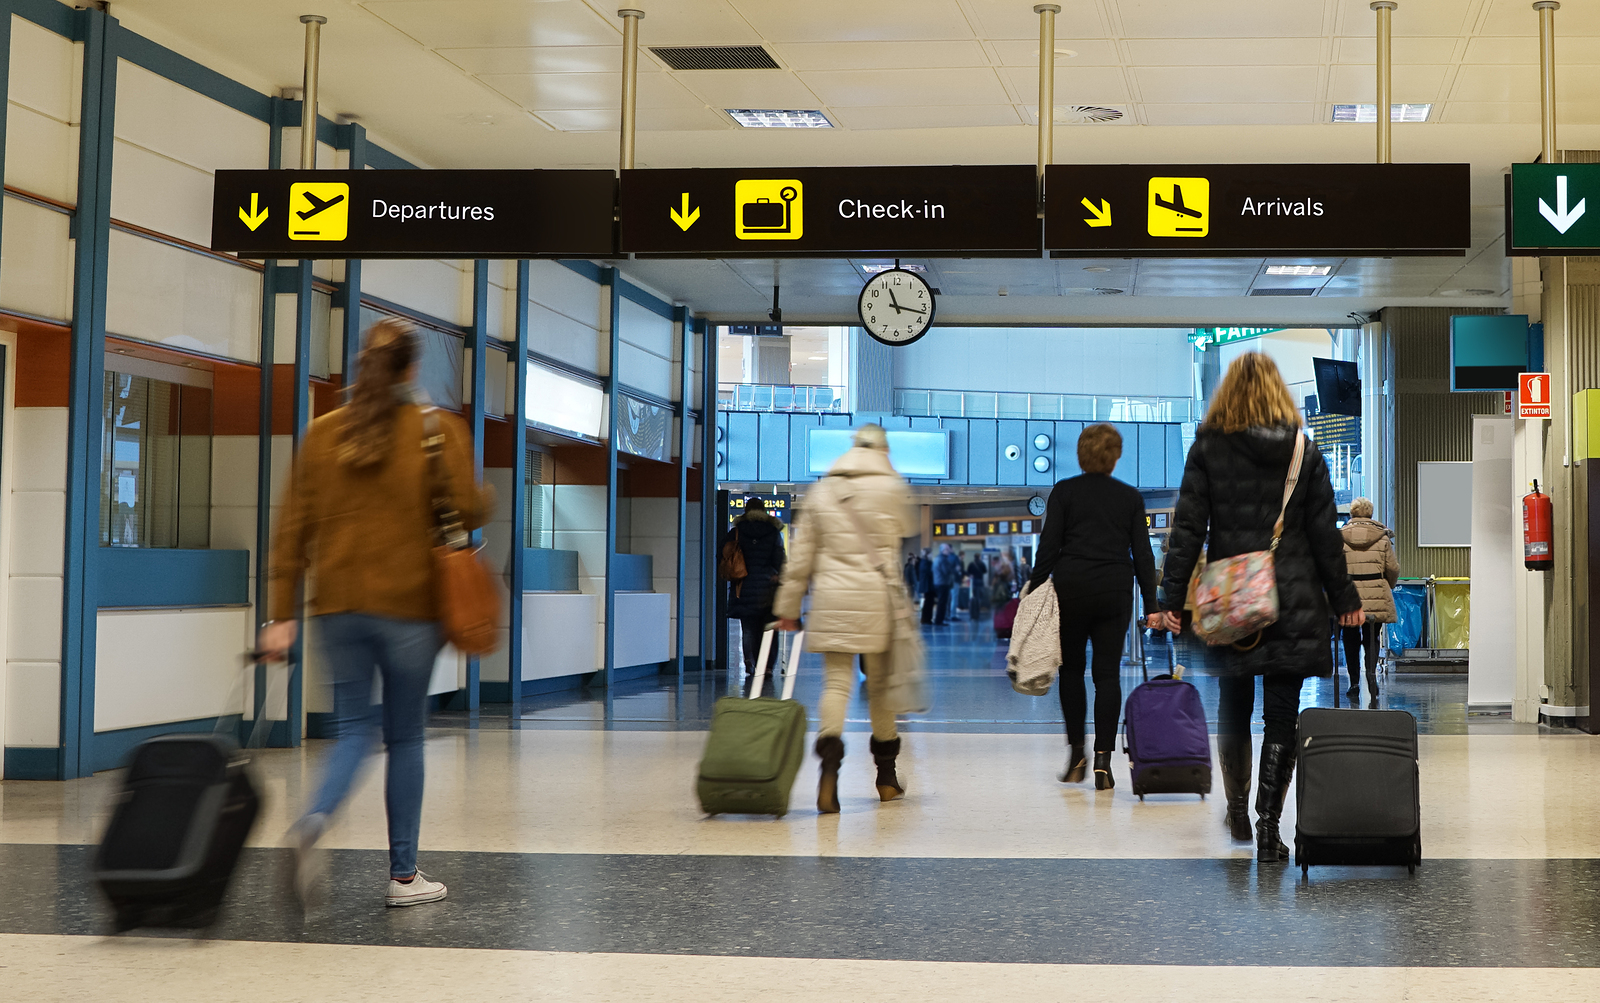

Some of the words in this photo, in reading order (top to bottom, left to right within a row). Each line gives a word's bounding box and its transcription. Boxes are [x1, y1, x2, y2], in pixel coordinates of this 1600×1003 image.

[372, 199, 495, 222] Departures
[838, 199, 945, 220] Check-in
[1240, 196, 1324, 217] Arrivals
[764, 500, 785, 508] 21:42
